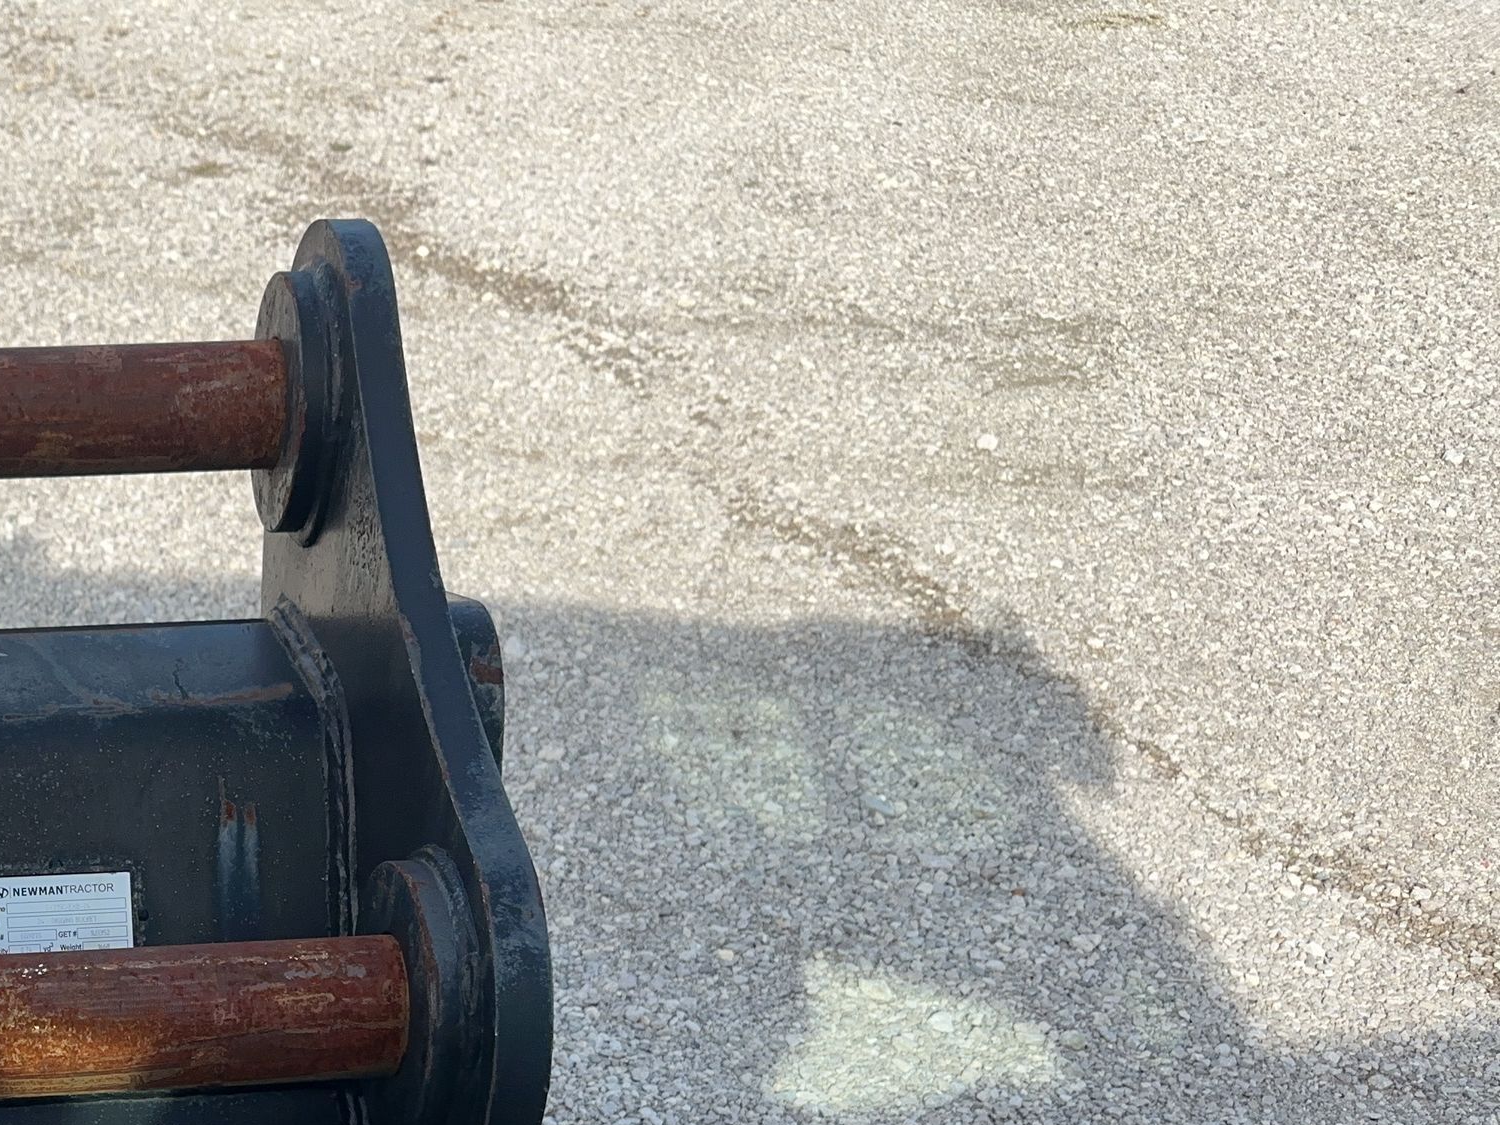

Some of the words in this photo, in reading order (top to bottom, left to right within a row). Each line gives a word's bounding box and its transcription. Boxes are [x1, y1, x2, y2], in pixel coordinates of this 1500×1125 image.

[12, 883, 114, 897] NEWMANTRACTOR
[57, 930, 72, 938] GET
[59, 943, 82, 951] Weight
